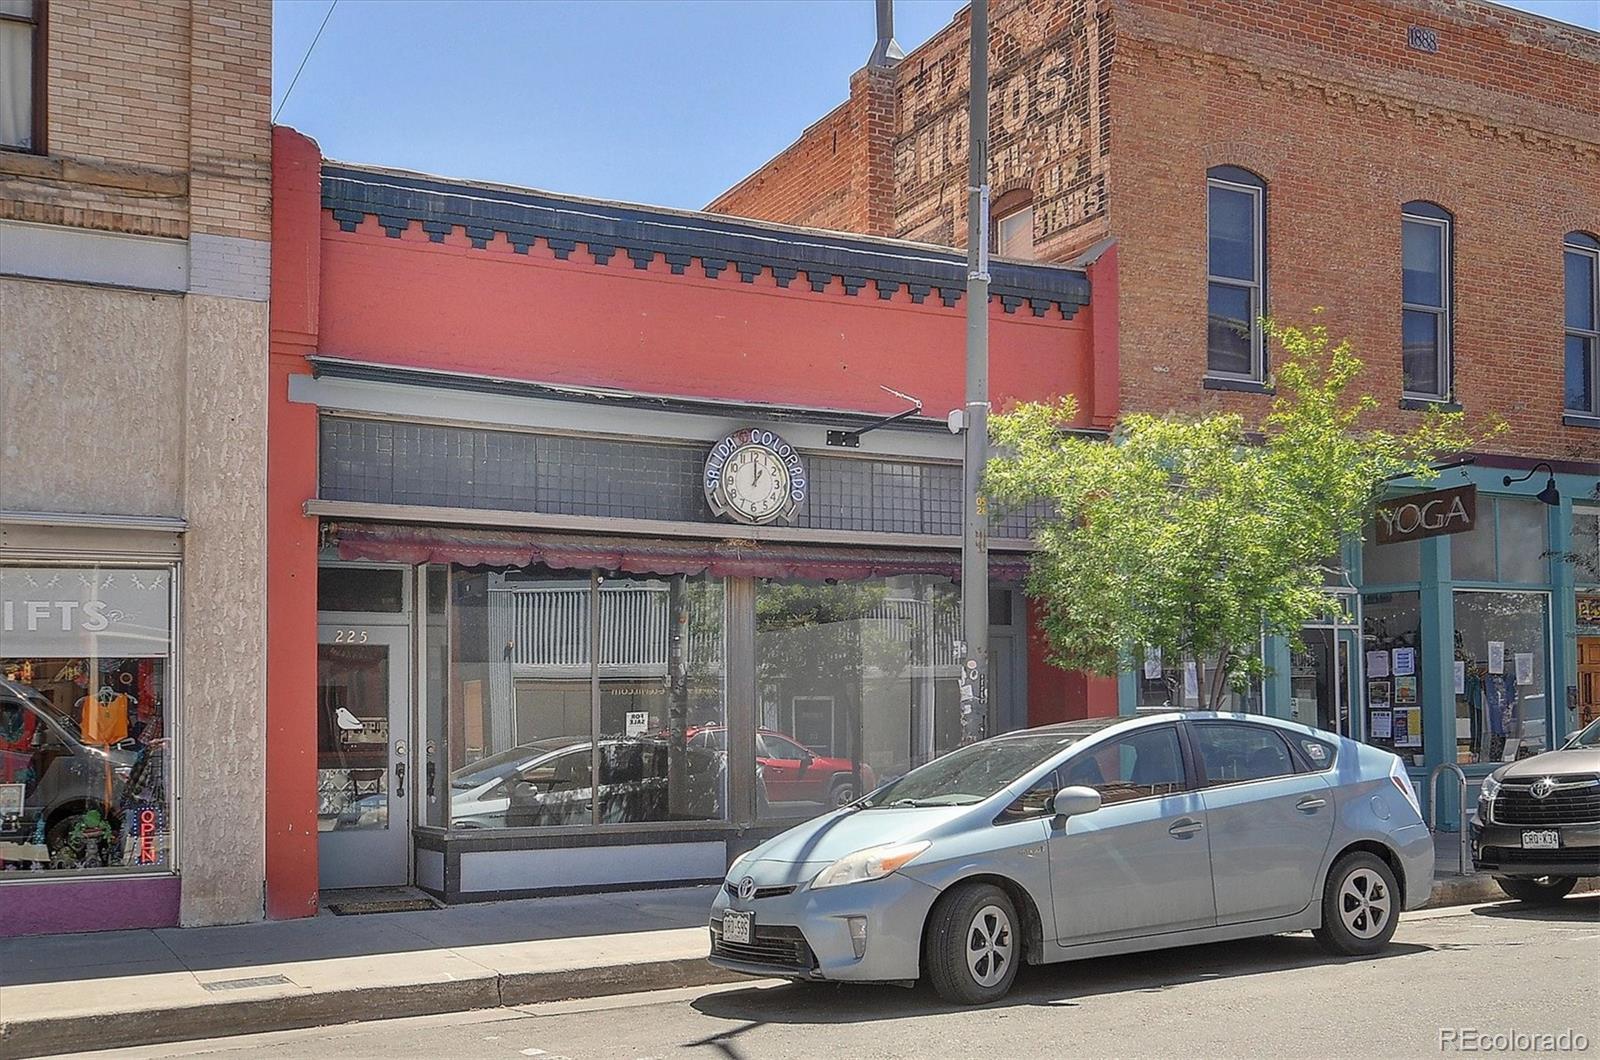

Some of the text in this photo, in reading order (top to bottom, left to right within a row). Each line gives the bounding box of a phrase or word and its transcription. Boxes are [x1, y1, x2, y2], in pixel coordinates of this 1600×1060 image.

[1411, 29, 1437, 50] 1888
[740, 453, 746, 464] 11
[750, 451, 759, 462] 12
[707, 429, 805, 501] SALIDA COLORADO
[730, 463, 738, 472] 10
[771, 466, 777, 477] 2
[728, 475, 734, 485] 9
[774, 480, 780, 490] 3
[730, 488, 737, 499] 8
[770, 492, 776, 501] 4
[740, 498, 746, 508] 7
[751, 502, 757, 512] 6
[763, 501, 768, 511] 5
[1377, 496, 1469, 536] YOGA
[4, 601, 109, 632] IFTS
[335, 630, 368, 644] 225
[141, 810, 156, 863] OPEN
